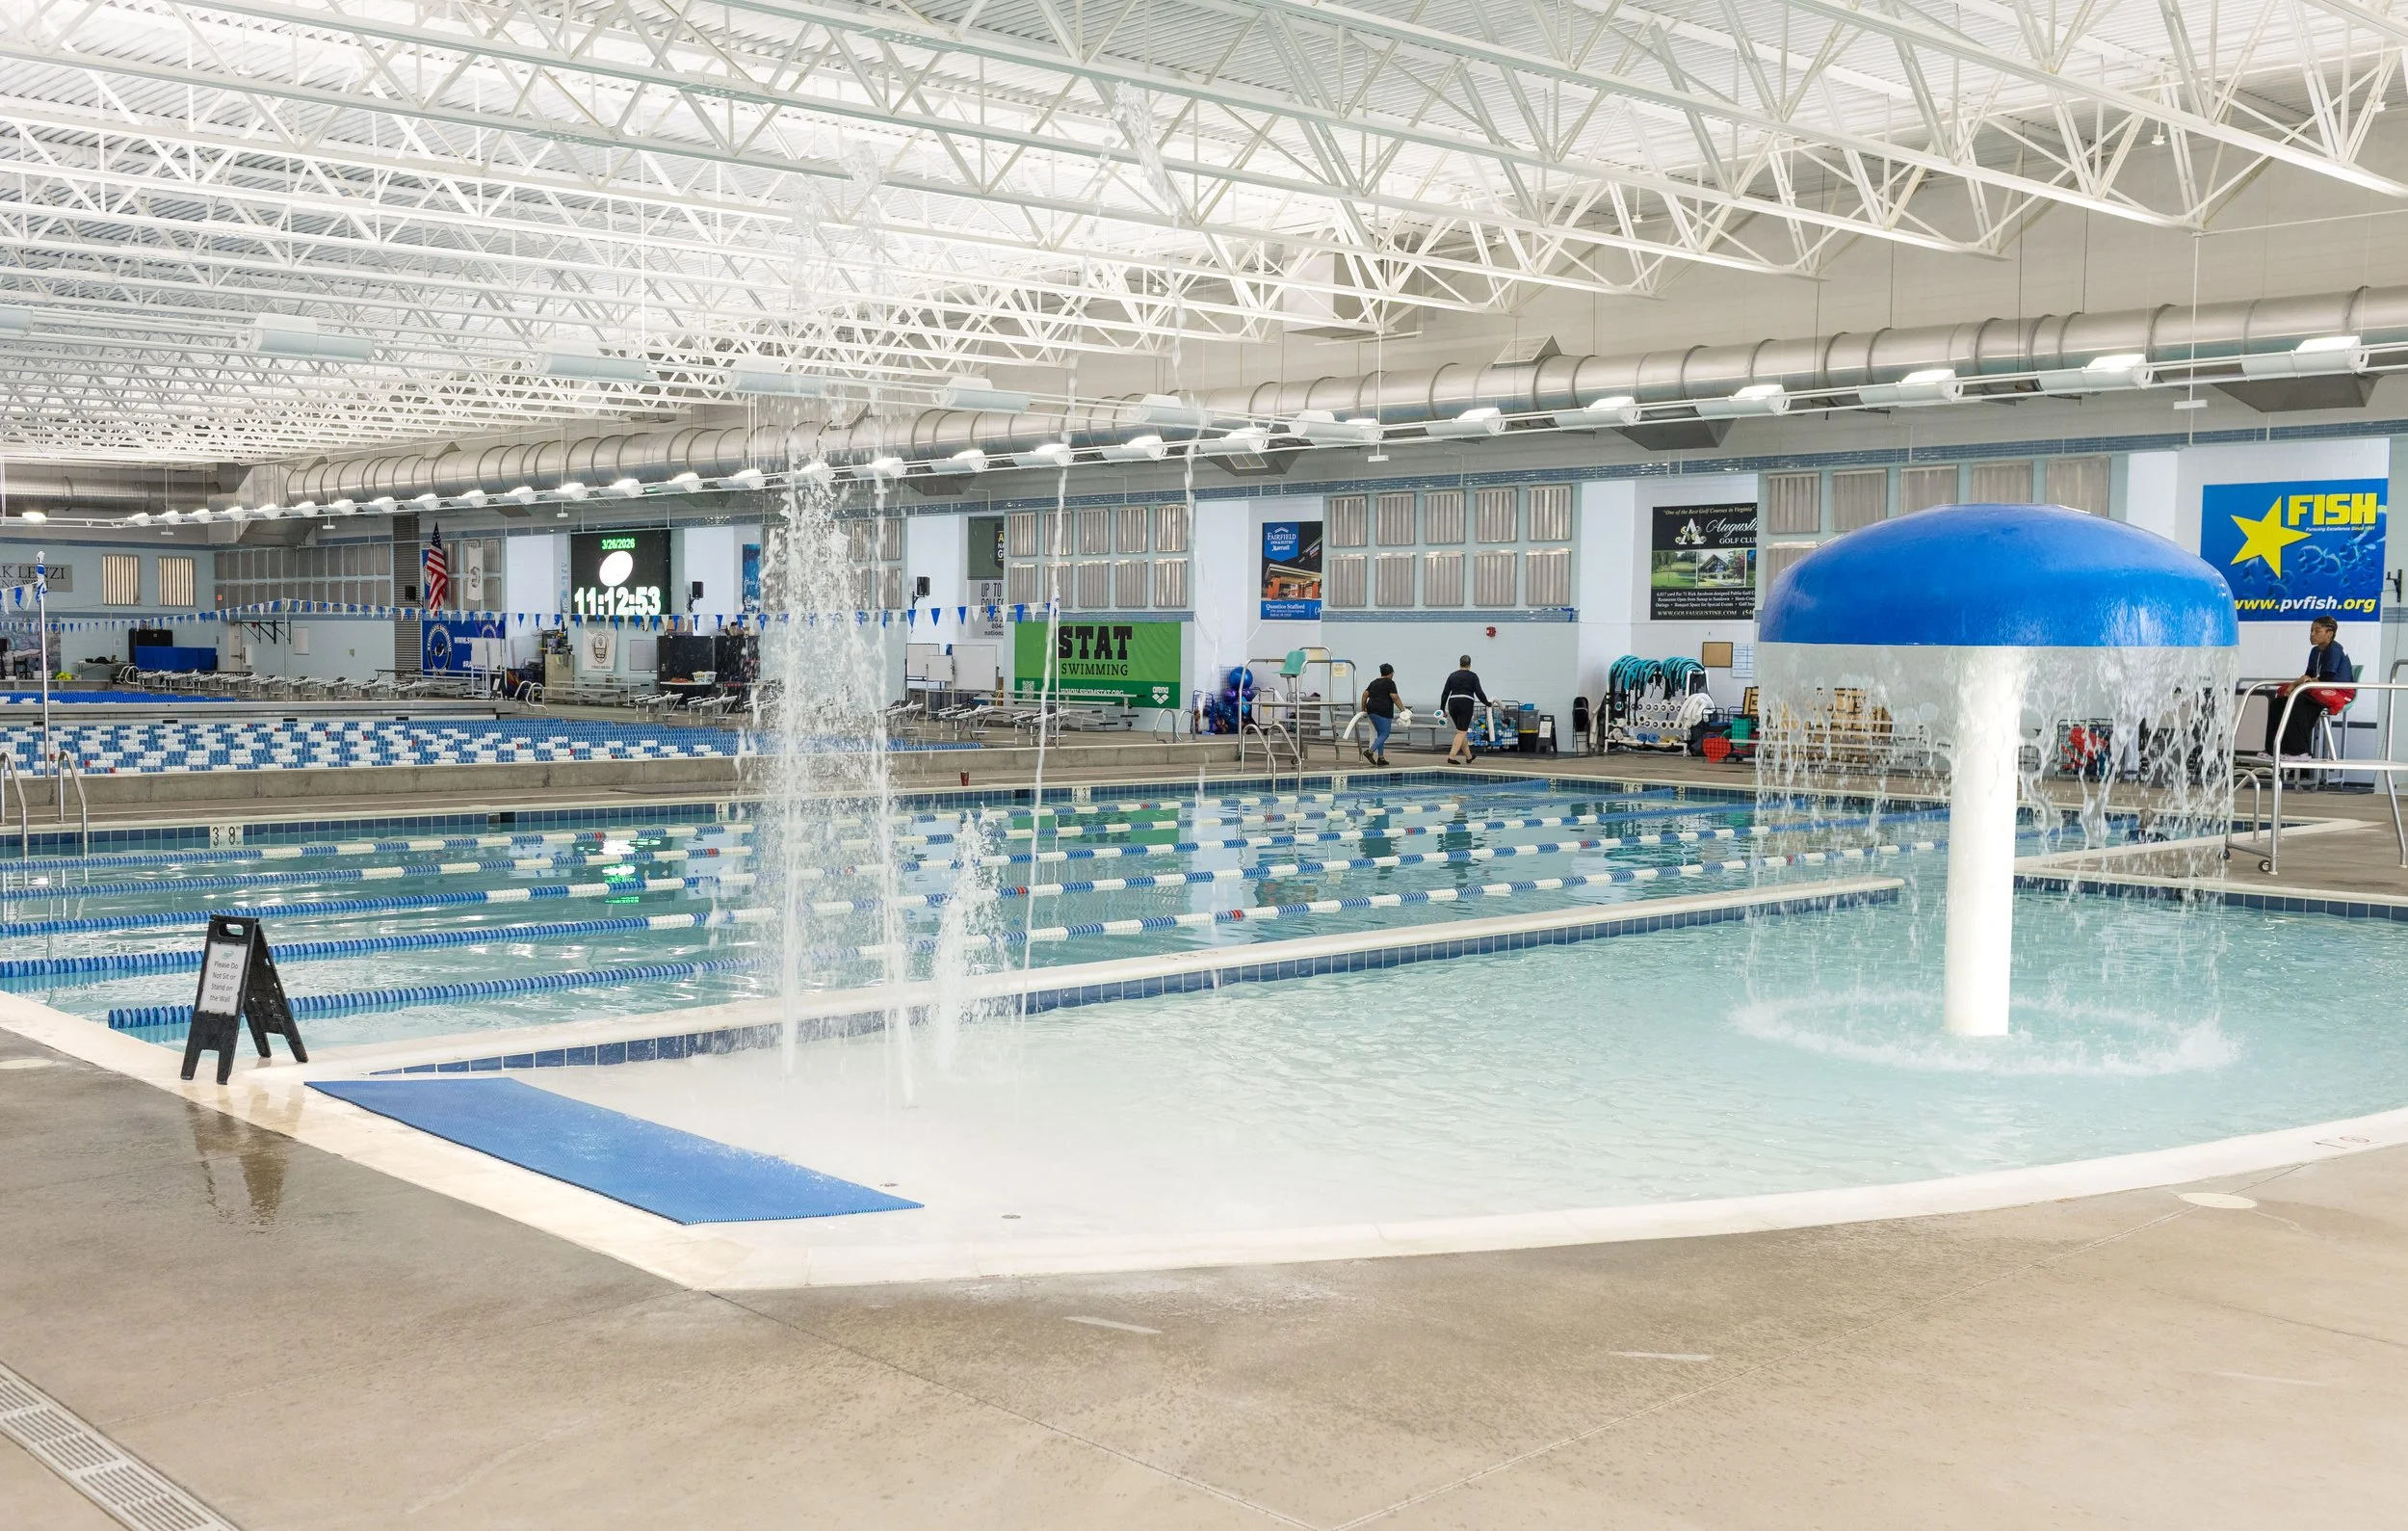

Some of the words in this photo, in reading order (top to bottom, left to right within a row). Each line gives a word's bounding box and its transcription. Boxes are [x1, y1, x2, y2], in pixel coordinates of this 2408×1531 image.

[2288, 492, 2377, 526] FISH
[998, 549, 1004, 559] G
[981, 582, 990, 597] UP
[993, 582, 1002, 597] TO
[574, 586, 662, 616] 11:12:53
[2235, 595, 2376, 613] www.pvfish.org
[1059, 625, 1133, 660] STAT
[1061, 662, 1129, 676] SWIMMING
